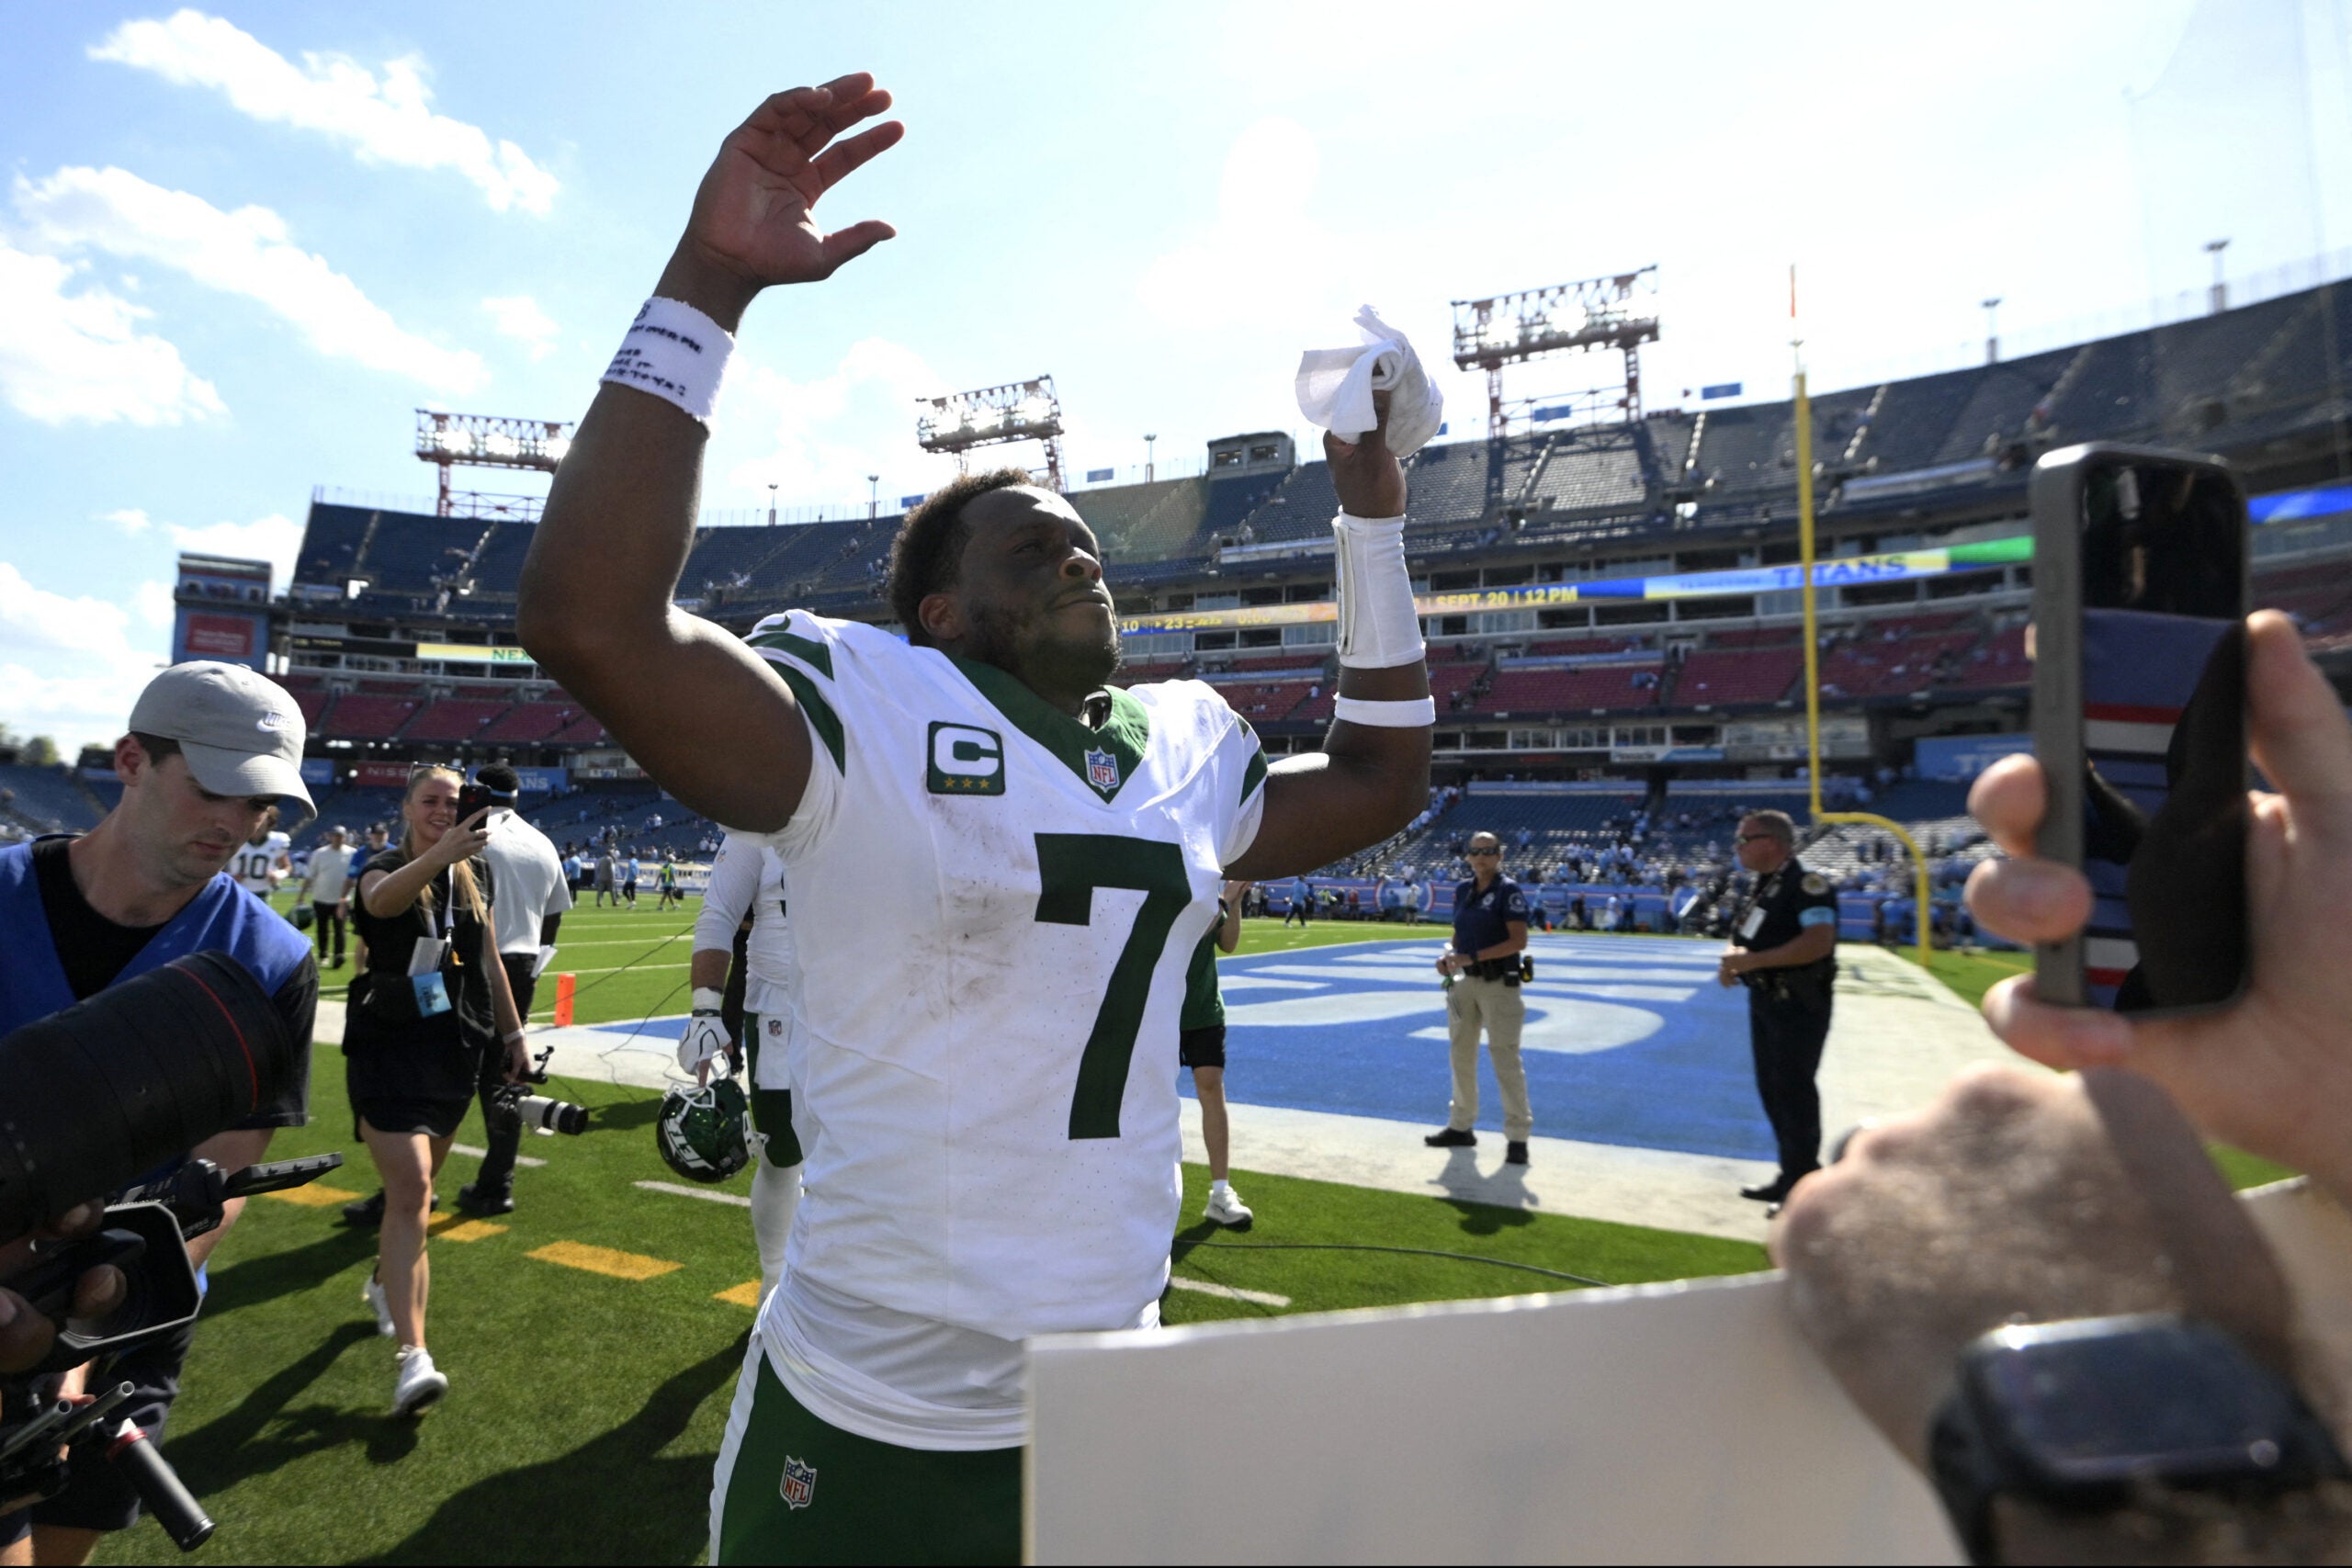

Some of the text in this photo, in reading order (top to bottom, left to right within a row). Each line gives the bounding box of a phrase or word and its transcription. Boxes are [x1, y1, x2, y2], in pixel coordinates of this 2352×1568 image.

[1772, 555, 1907, 586] TITANS
[1435, 586, 1578, 608] SEPT. 20 12 PM
[1122, 620, 1139, 633] 10
[1164, 616, 1184, 630] 23
[493, 649, 531, 660] NEX
[934, 727, 999, 776] C
[367, 767, 411, 776] NISS
[1093, 765, 1115, 783] NFL
[239, 853, 269, 879] 10
[1035, 832, 1193, 1140] 7
[785, 1476, 808, 1501] NFL
